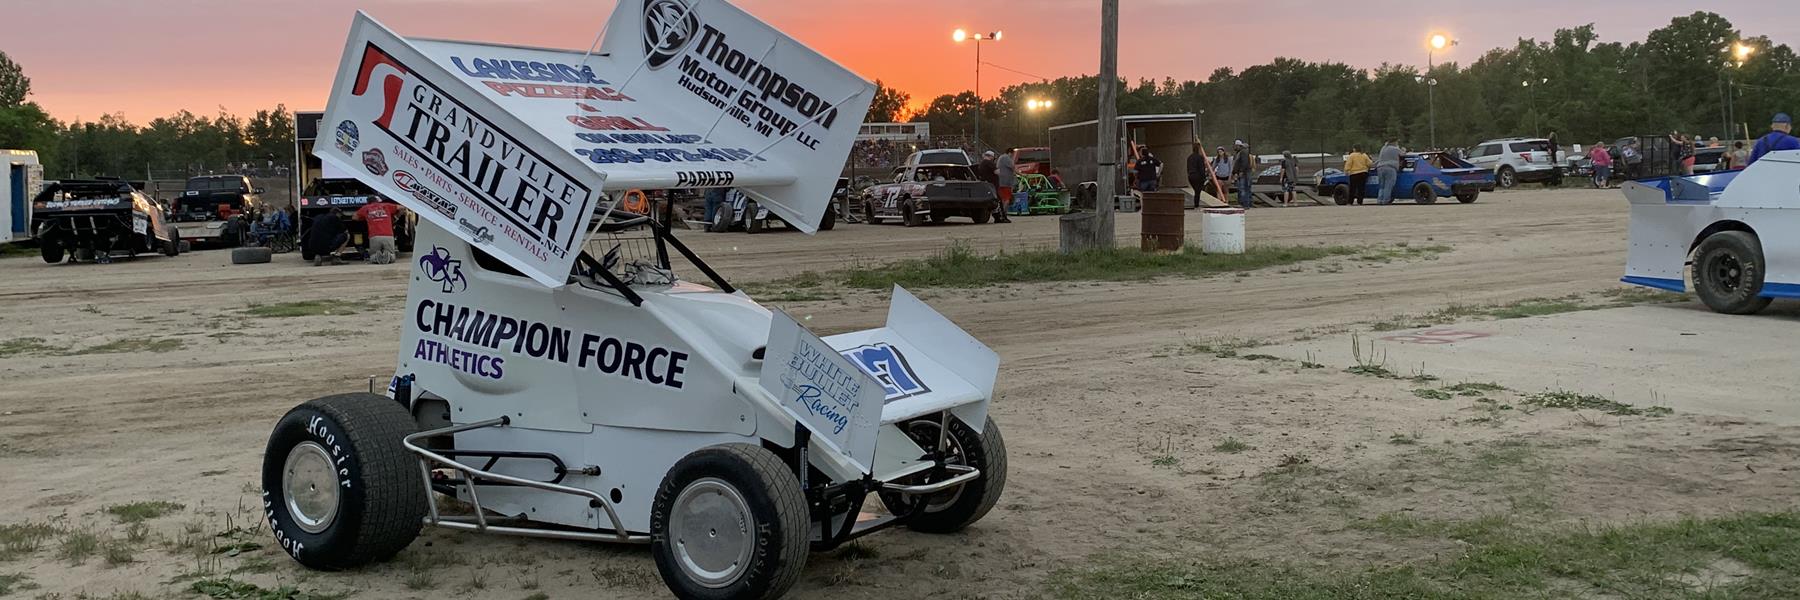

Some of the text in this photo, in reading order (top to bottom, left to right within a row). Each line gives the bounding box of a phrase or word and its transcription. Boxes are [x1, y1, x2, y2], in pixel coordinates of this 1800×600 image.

[450, 56, 610, 85] LAKESIDE
[695, 23, 838, 130] Thompson
[566, 116, 671, 132] GRILL
[677, 54, 821, 151] Motor Group LLC
[677, 75, 774, 138] Hudsonville, MI
[405, 102, 565, 242] TRAILER
[413, 84, 576, 205] GRANDVILLE
[392, 145, 419, 170] SALES
[425, 167, 452, 194] PARTS
[457, 190, 499, 226] SERVICE
[503, 223, 550, 263] RENTALS
[675, 170, 735, 187] PARKER
[414, 338, 505, 379] ATHLETICS
[415, 298, 689, 390] CHAMPION FORCE
[800, 339, 860, 398] WHITE
[788, 356, 859, 413] BULLET
[796, 384, 848, 435] Racing
[306, 415, 352, 488] Hoosier
